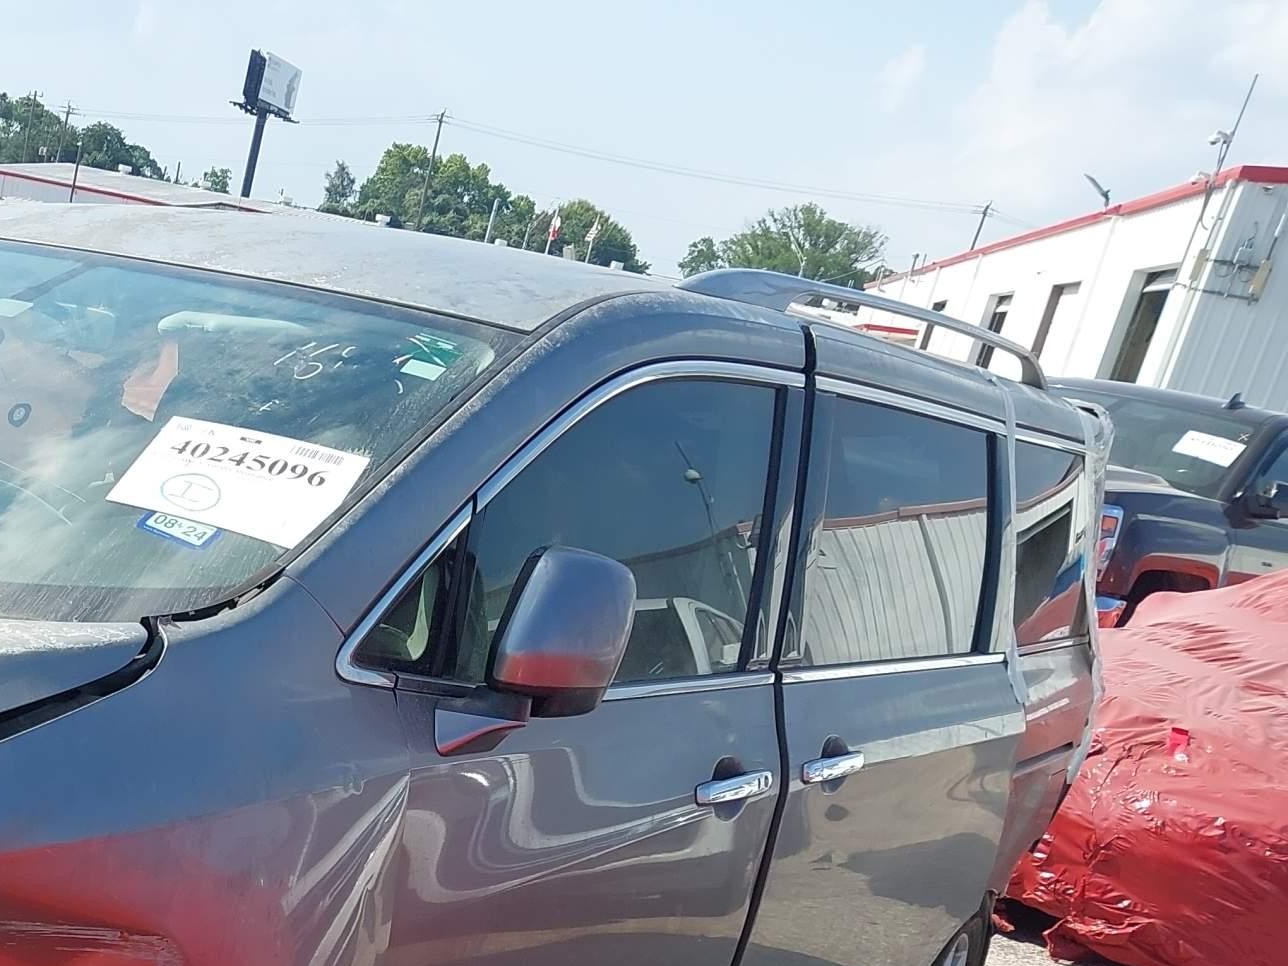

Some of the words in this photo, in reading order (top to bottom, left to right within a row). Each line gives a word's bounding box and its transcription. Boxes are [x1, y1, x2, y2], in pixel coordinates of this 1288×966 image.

[170, 439, 327, 488] 40245096
[153, 514, 178, 529] 08
[182, 526, 207, 541] 24
